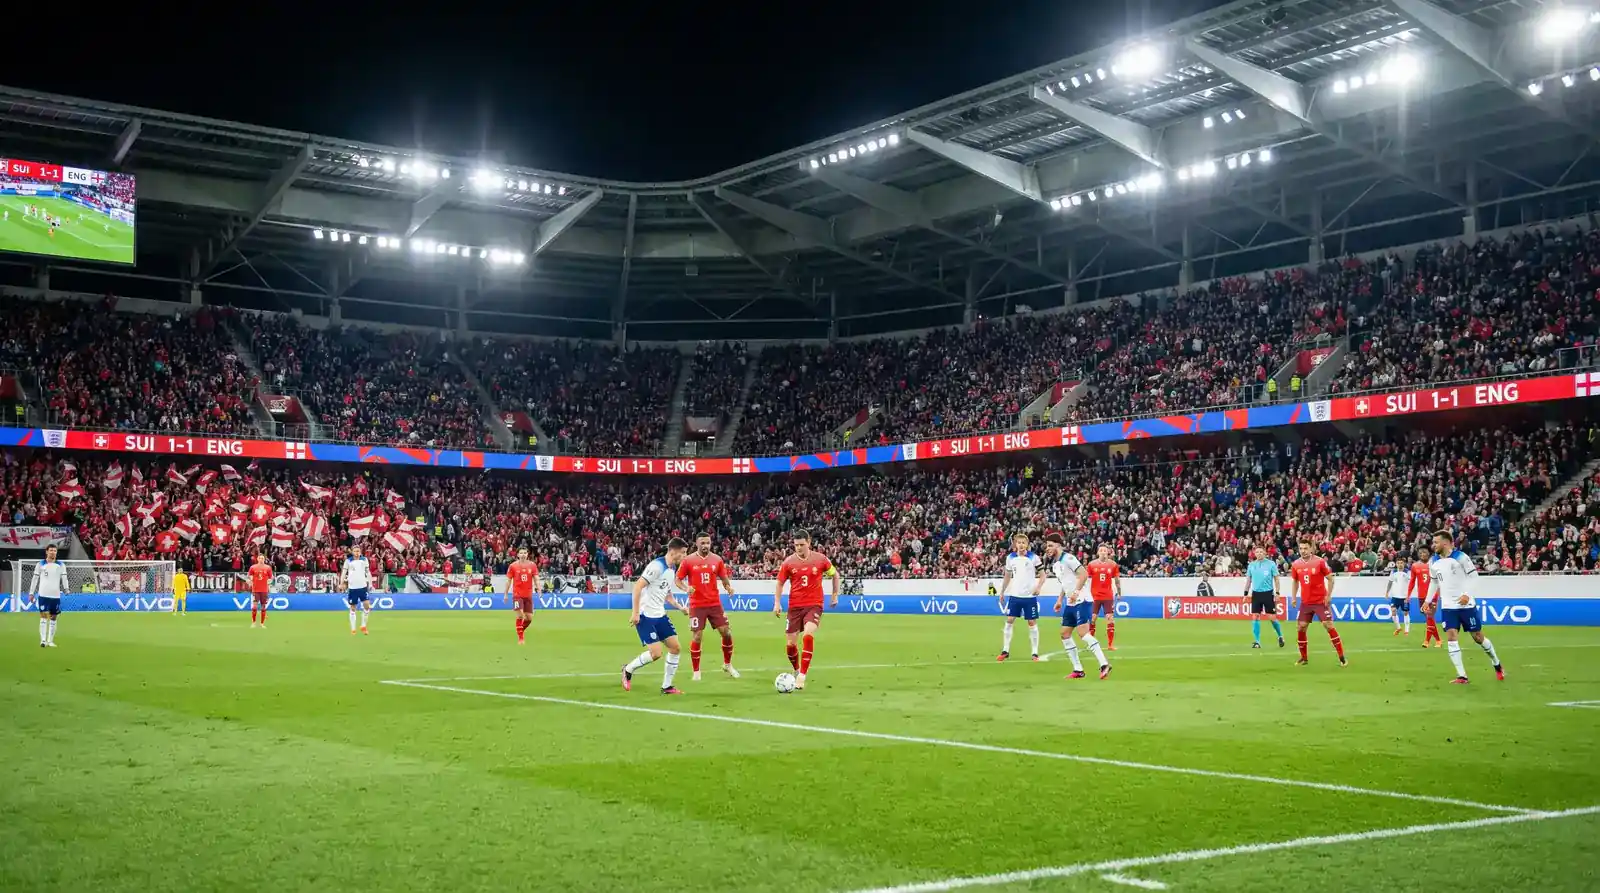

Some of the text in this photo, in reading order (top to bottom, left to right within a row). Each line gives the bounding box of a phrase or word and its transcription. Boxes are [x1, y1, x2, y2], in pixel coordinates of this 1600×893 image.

[13, 164, 87, 181] SUI 1-1 ENG
[1386, 383, 1519, 413] SUI 1-1 ENG
[125, 435, 243, 456] SUI 1-1 ENG
[951, 432, 1030, 454] SUI 1-1 ENG
[597, 459, 696, 473] SUI 1-1 ENG
[701, 573, 710, 584] 19
[801, 575, 808, 587] 3
[1304, 575, 1310, 584] 9
[116, 594, 174, 611] vivo
[444, 595, 493, 609] vivo
[540, 594, 584, 608] vivo
[730, 595, 758, 610] vivo
[850, 596, 884, 612] vivo
[920, 596, 958, 613] vivo
[1183, 602, 1239, 615] EUROPEAN
[1331, 599, 1393, 620] vivo
[1477, 600, 1532, 622] ivo
